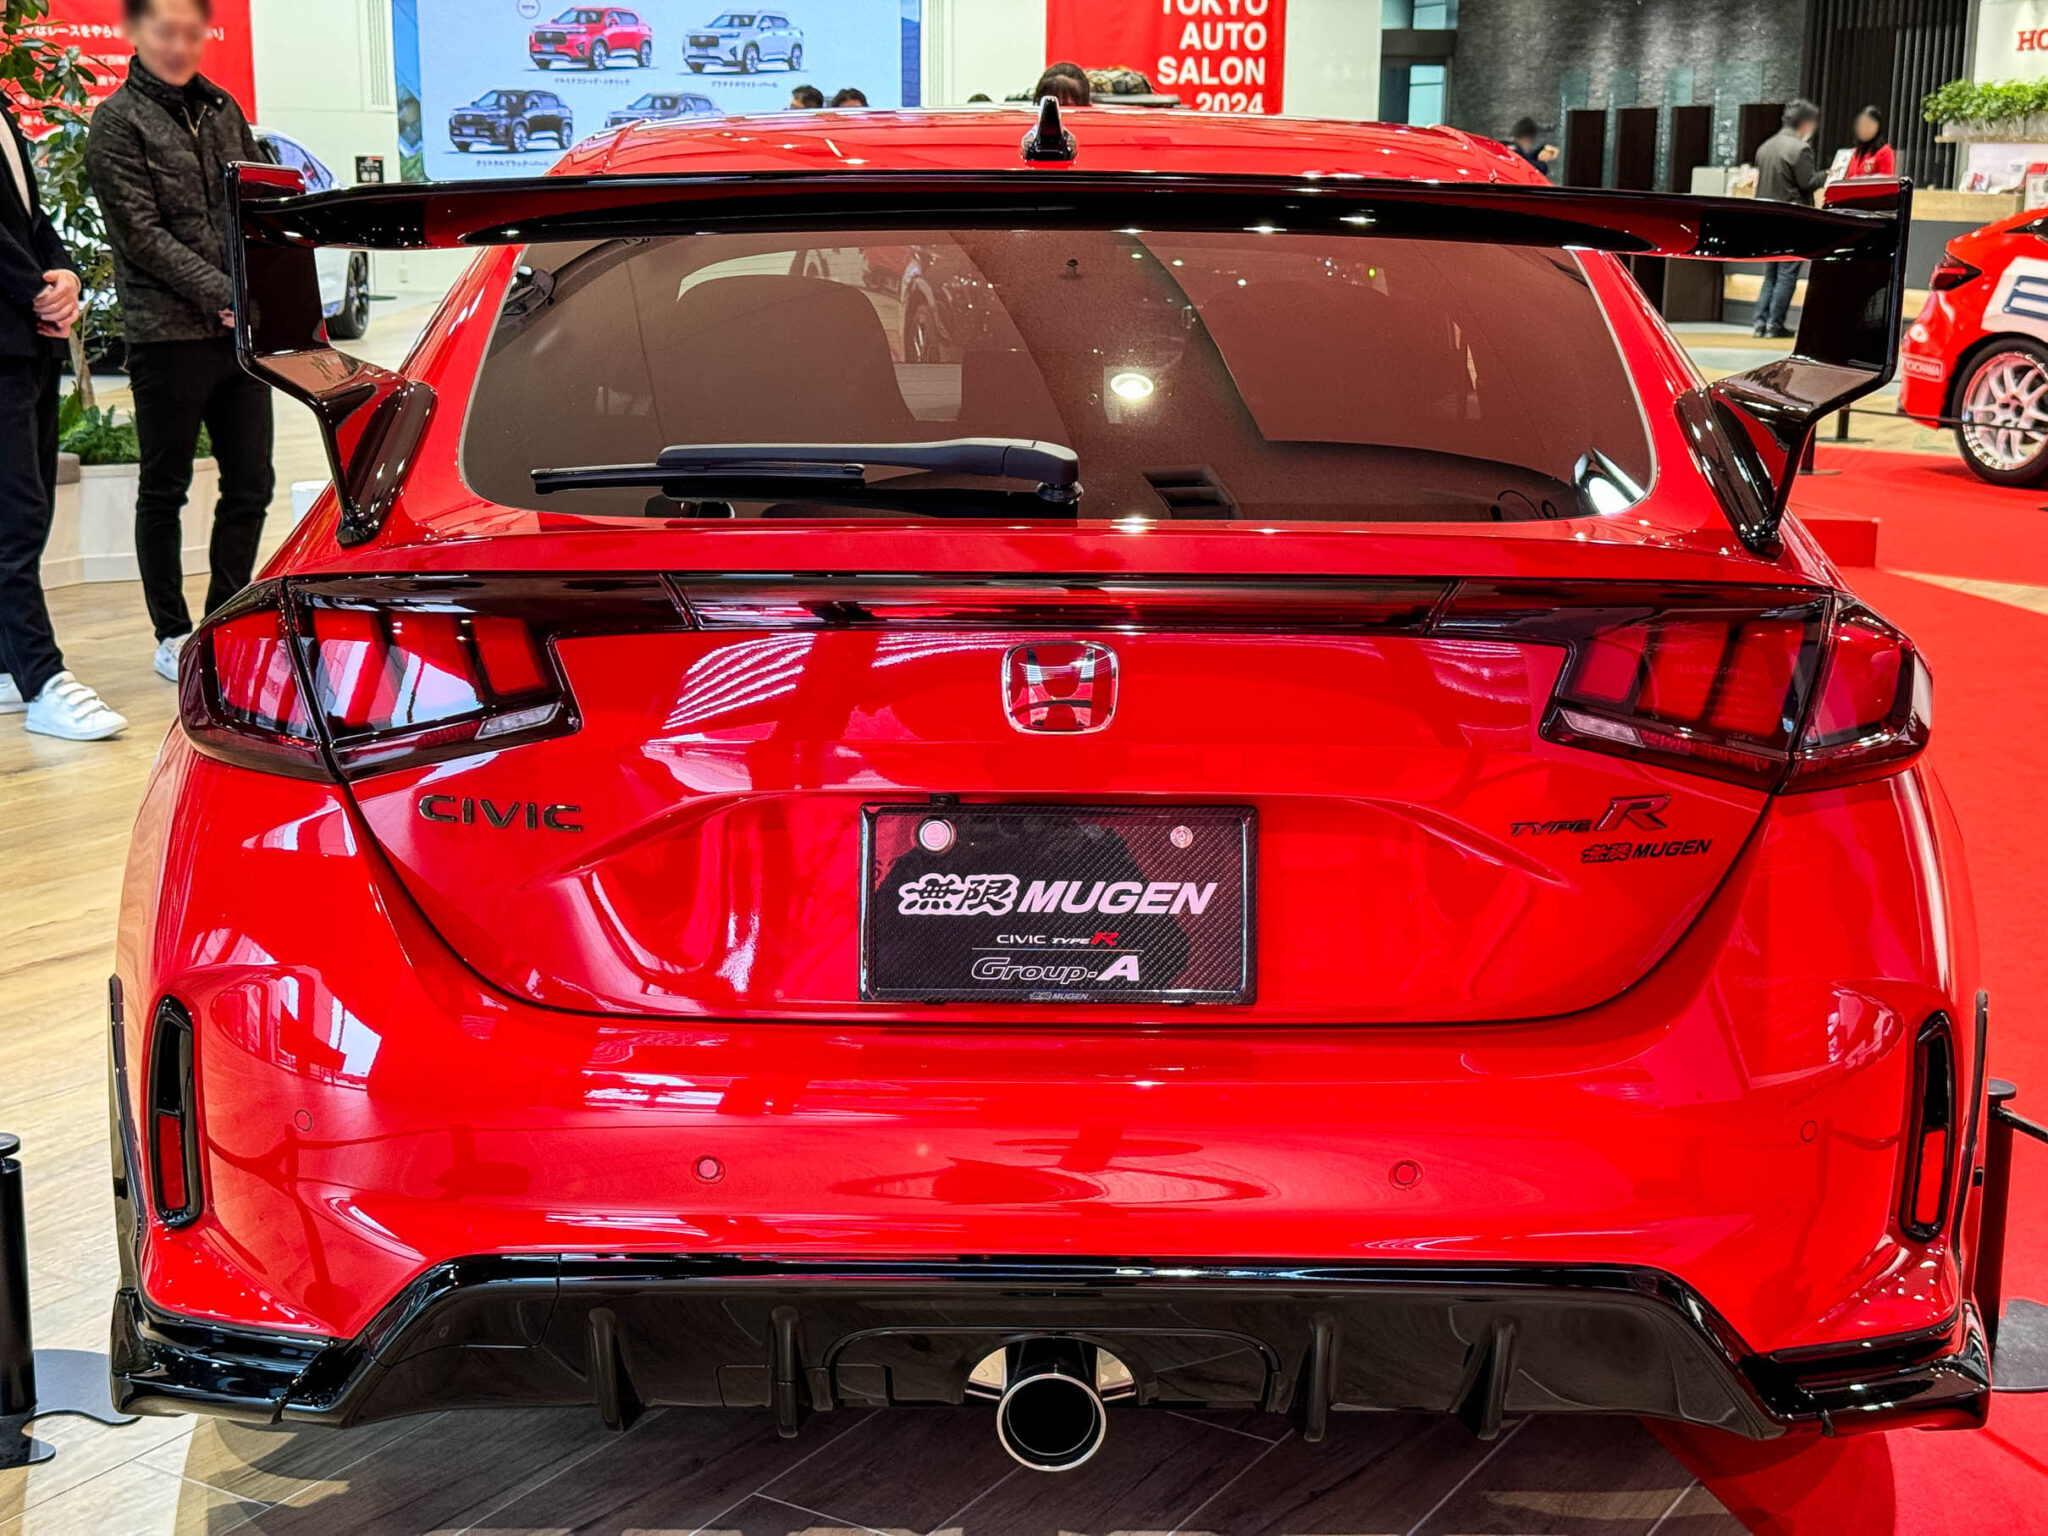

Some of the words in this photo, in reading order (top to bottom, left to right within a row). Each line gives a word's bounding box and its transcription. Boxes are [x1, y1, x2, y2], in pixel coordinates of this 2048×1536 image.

[1179, 21, 1267, 51] AUTO
[1157, 56, 1266, 85] SALON
[1195, 92, 1265, 113] 2024
[418, 794, 584, 832] CIVIC
[1510, 819, 1594, 836] TYPE
[1594, 794, 1672, 831] R
[1632, 838, 1713, 859] MUGEN
[898, 873, 1020, 916] 無限
[1017, 880, 1218, 915] MUGEN
[996, 934, 1046, 944] CIVIC
[1050, 937, 1090, 945] TYPE
[1090, 931, 1120, 946] R
[971, 955, 1140, 985] Group-A
[1052, 992, 1089, 1000] MUGEN
